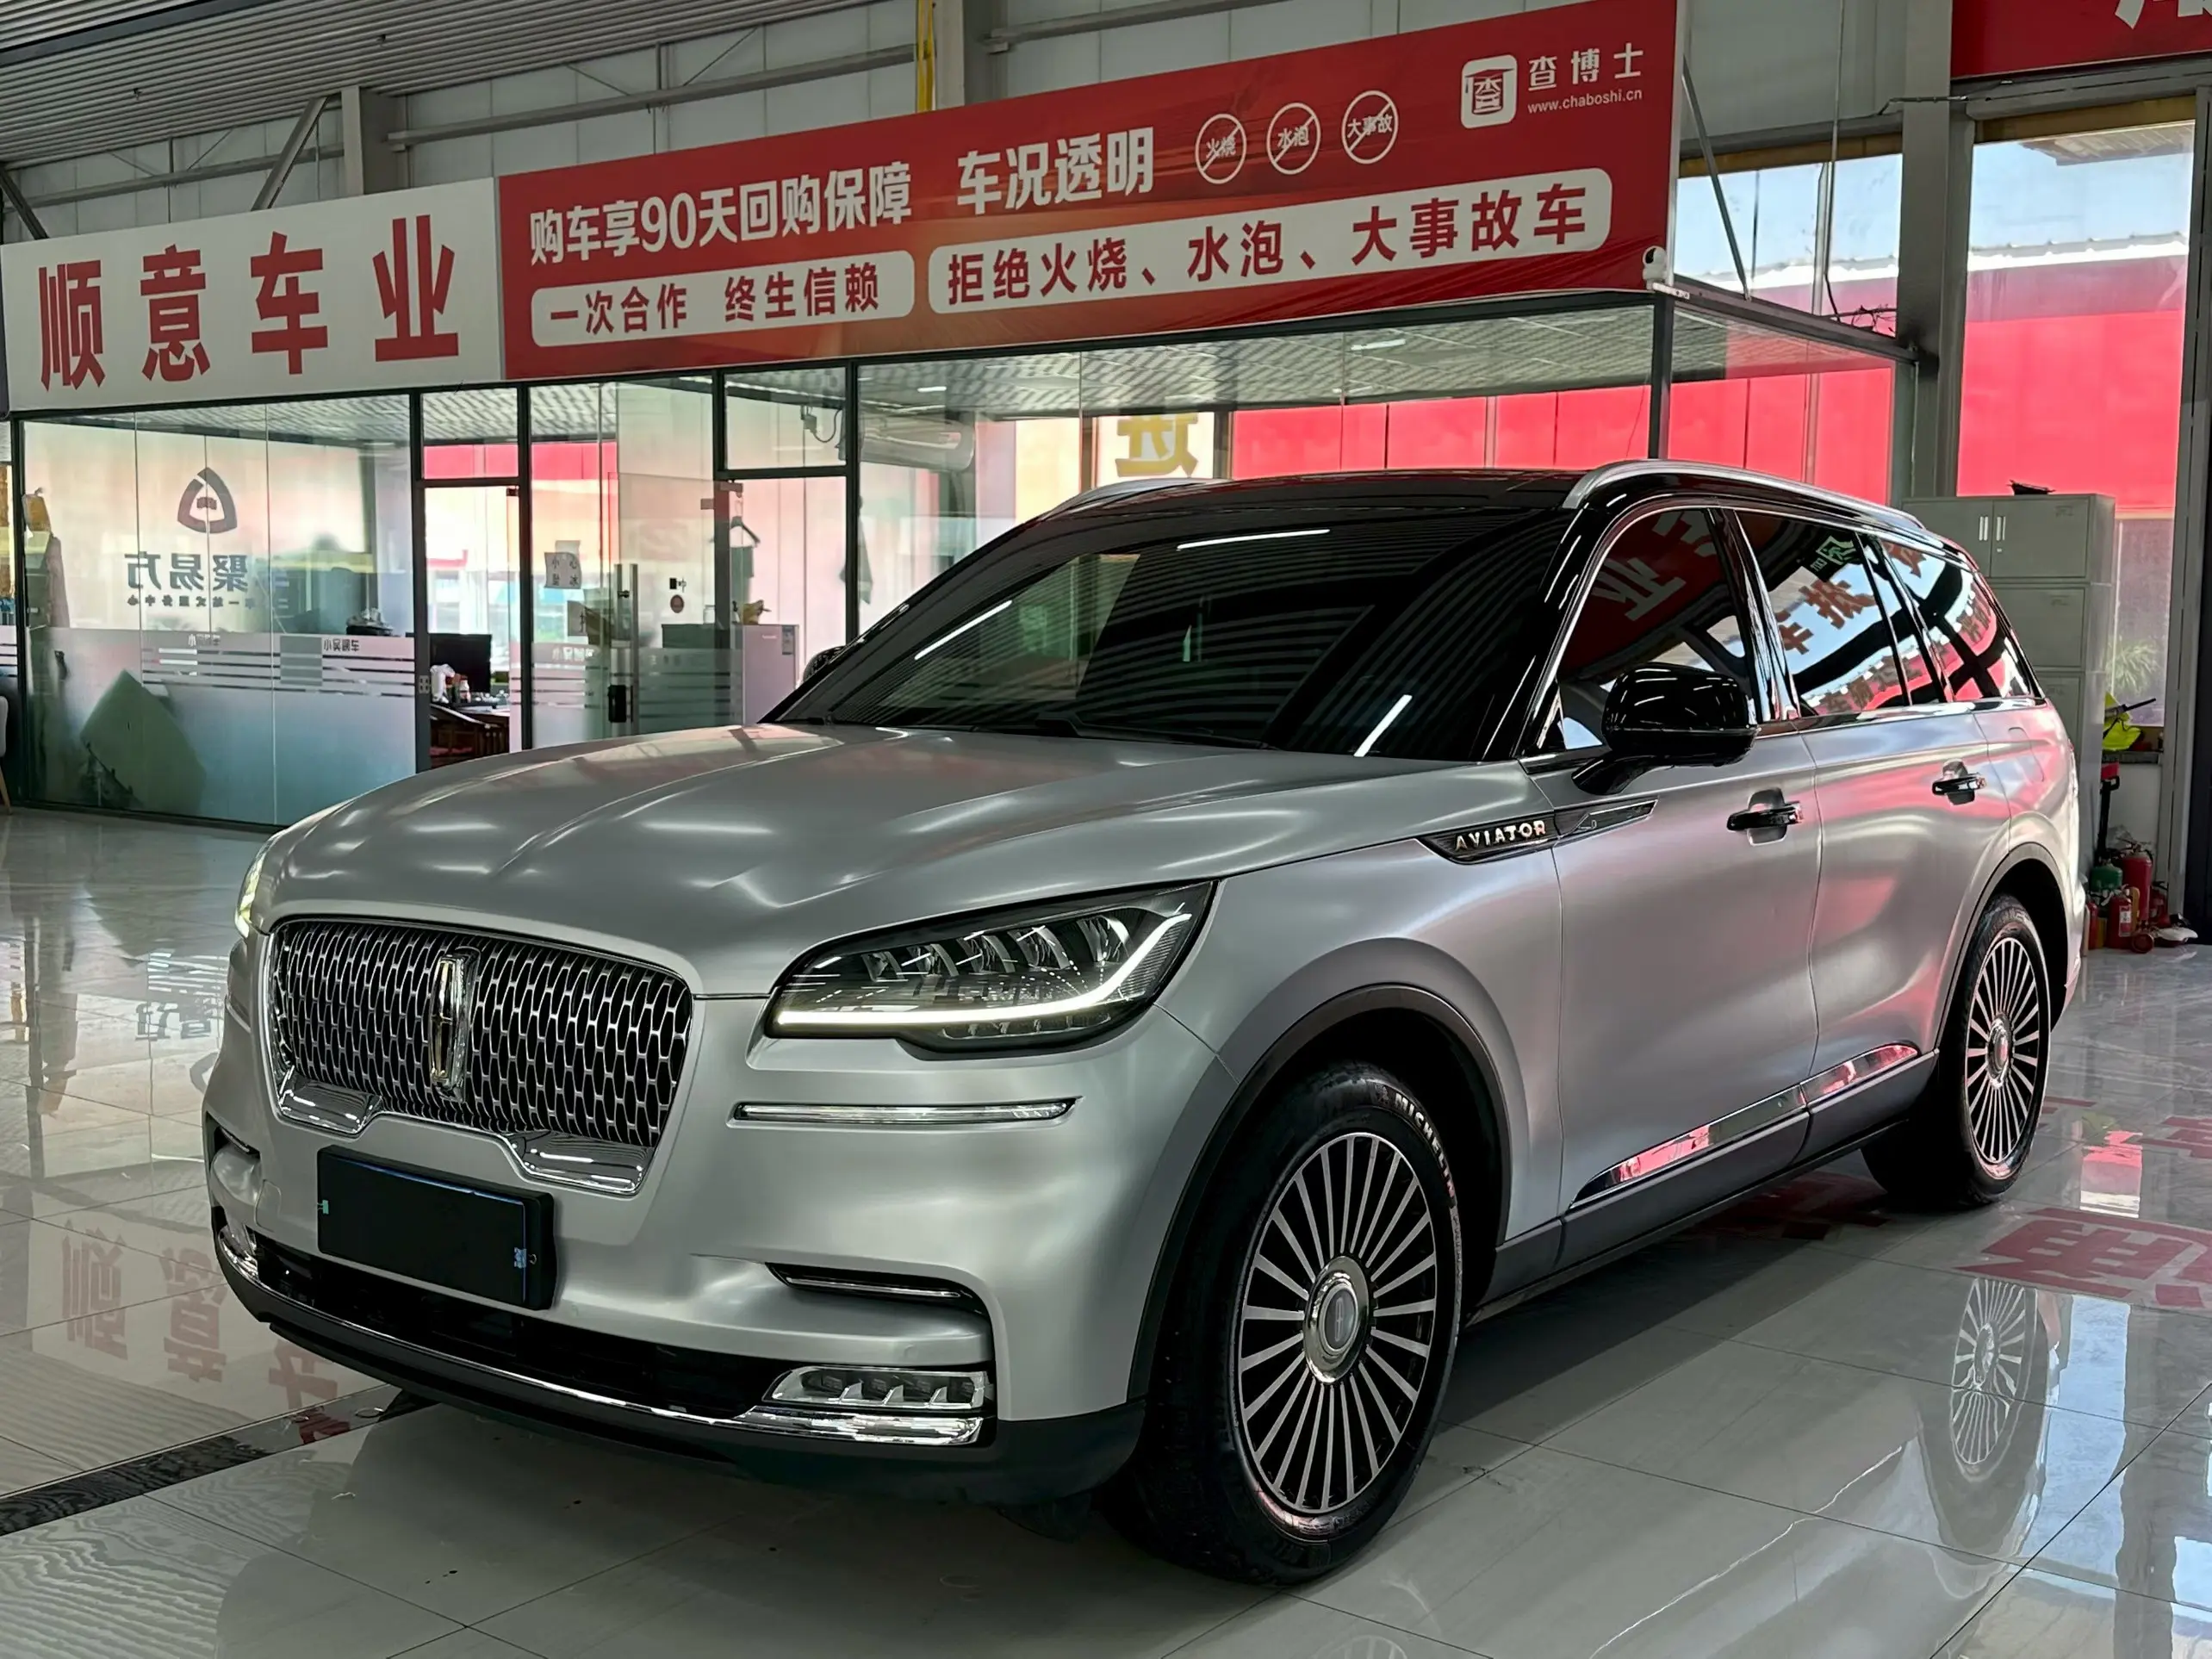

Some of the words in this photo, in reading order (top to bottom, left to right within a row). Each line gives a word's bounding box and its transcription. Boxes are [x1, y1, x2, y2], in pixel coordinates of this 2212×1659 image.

[1526, 88, 1643, 115] www.chaboshi.cn
[530, 160, 911, 265] 购车享90天回购保障
[957, 127, 1154, 214] 车况透明
[948, 183, 1587, 306] 拒绝火烧、水泡、大事故车
[39, 214, 459, 391] 顺意车业
[550, 282, 688, 335] 一次合作
[724, 262, 879, 323] 终生信赖
[1454, 820, 1547, 852] AVIATOR
[1394, 1090, 1457, 1201] MICHELIN
